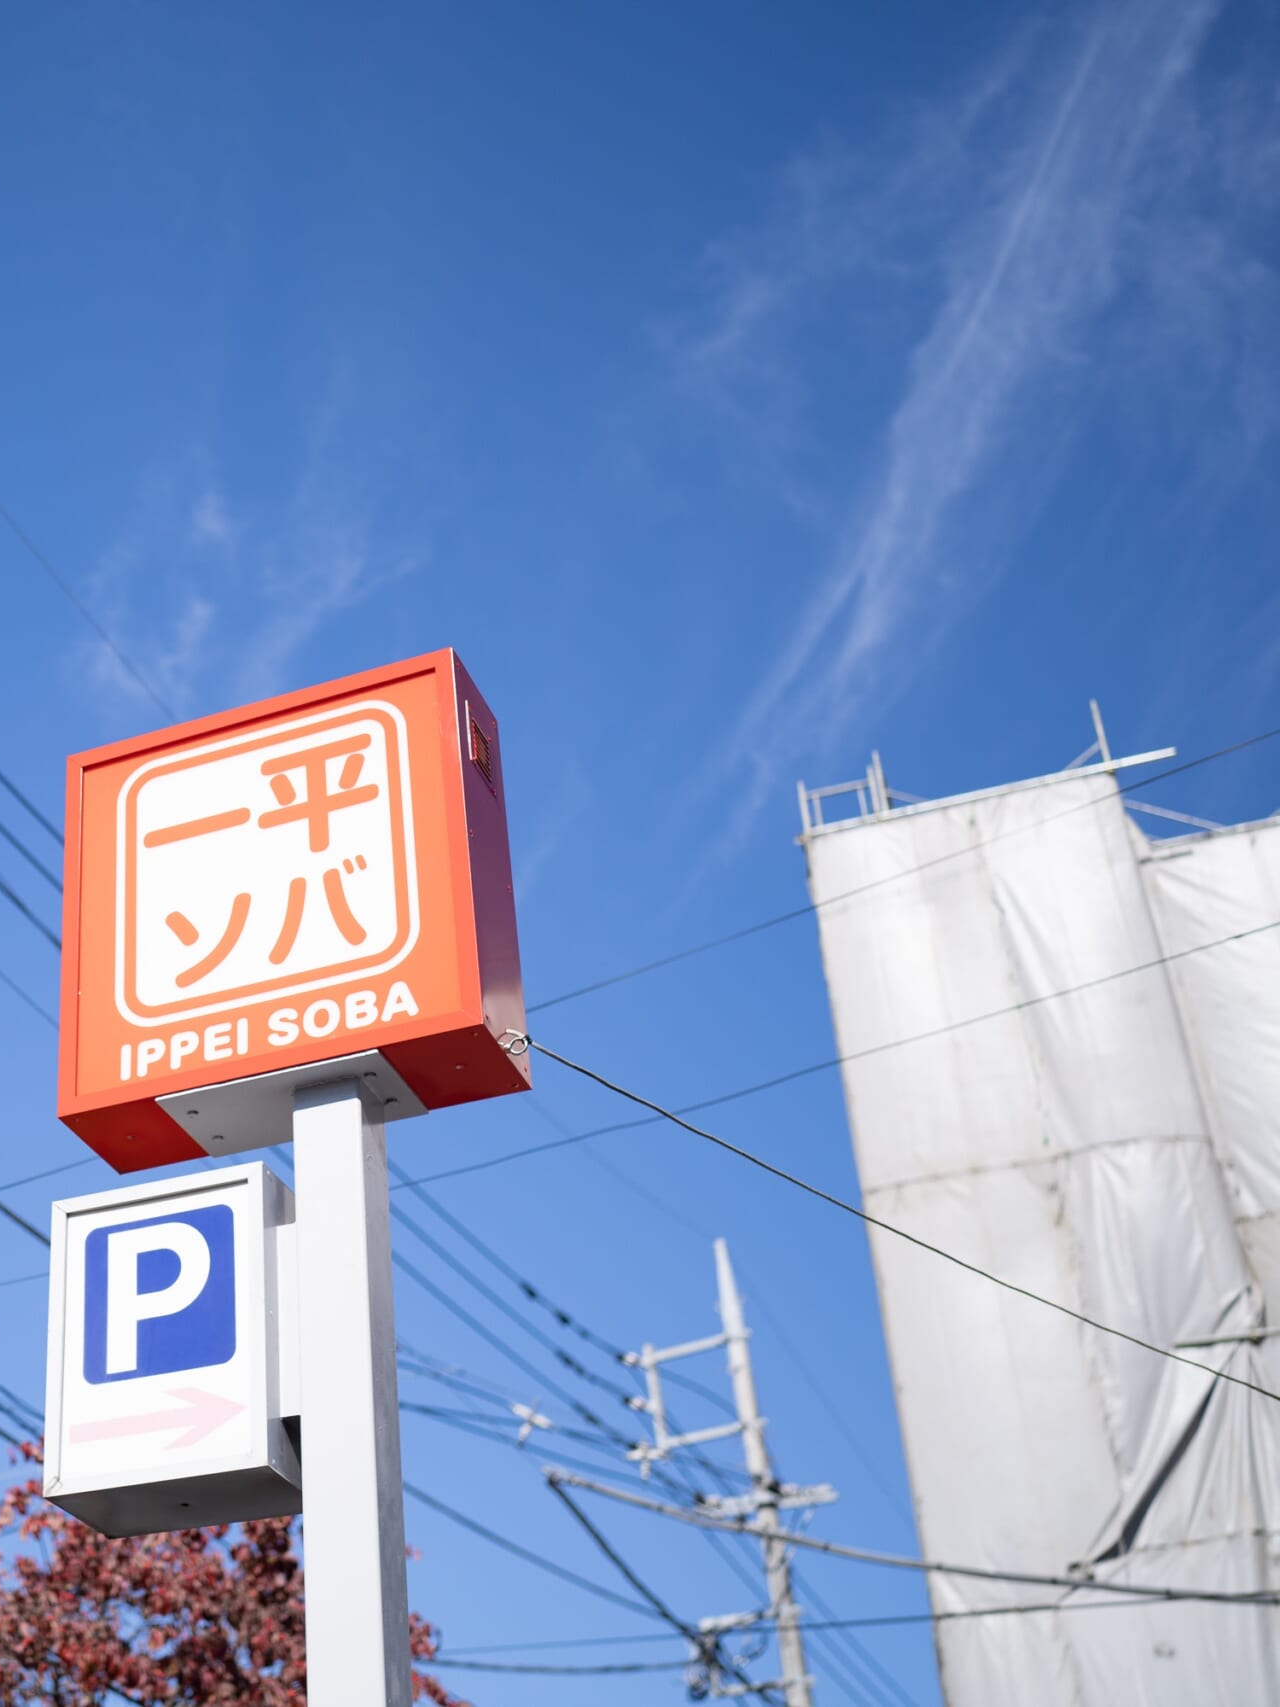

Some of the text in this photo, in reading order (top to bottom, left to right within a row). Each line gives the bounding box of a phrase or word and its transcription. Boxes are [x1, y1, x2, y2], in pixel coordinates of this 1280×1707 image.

[144, 733, 379, 852] 一平
[166, 855, 367, 987] ソバ
[120, 981, 419, 1080] IPPEI SOBA
[107, 1222, 211, 1375] P
